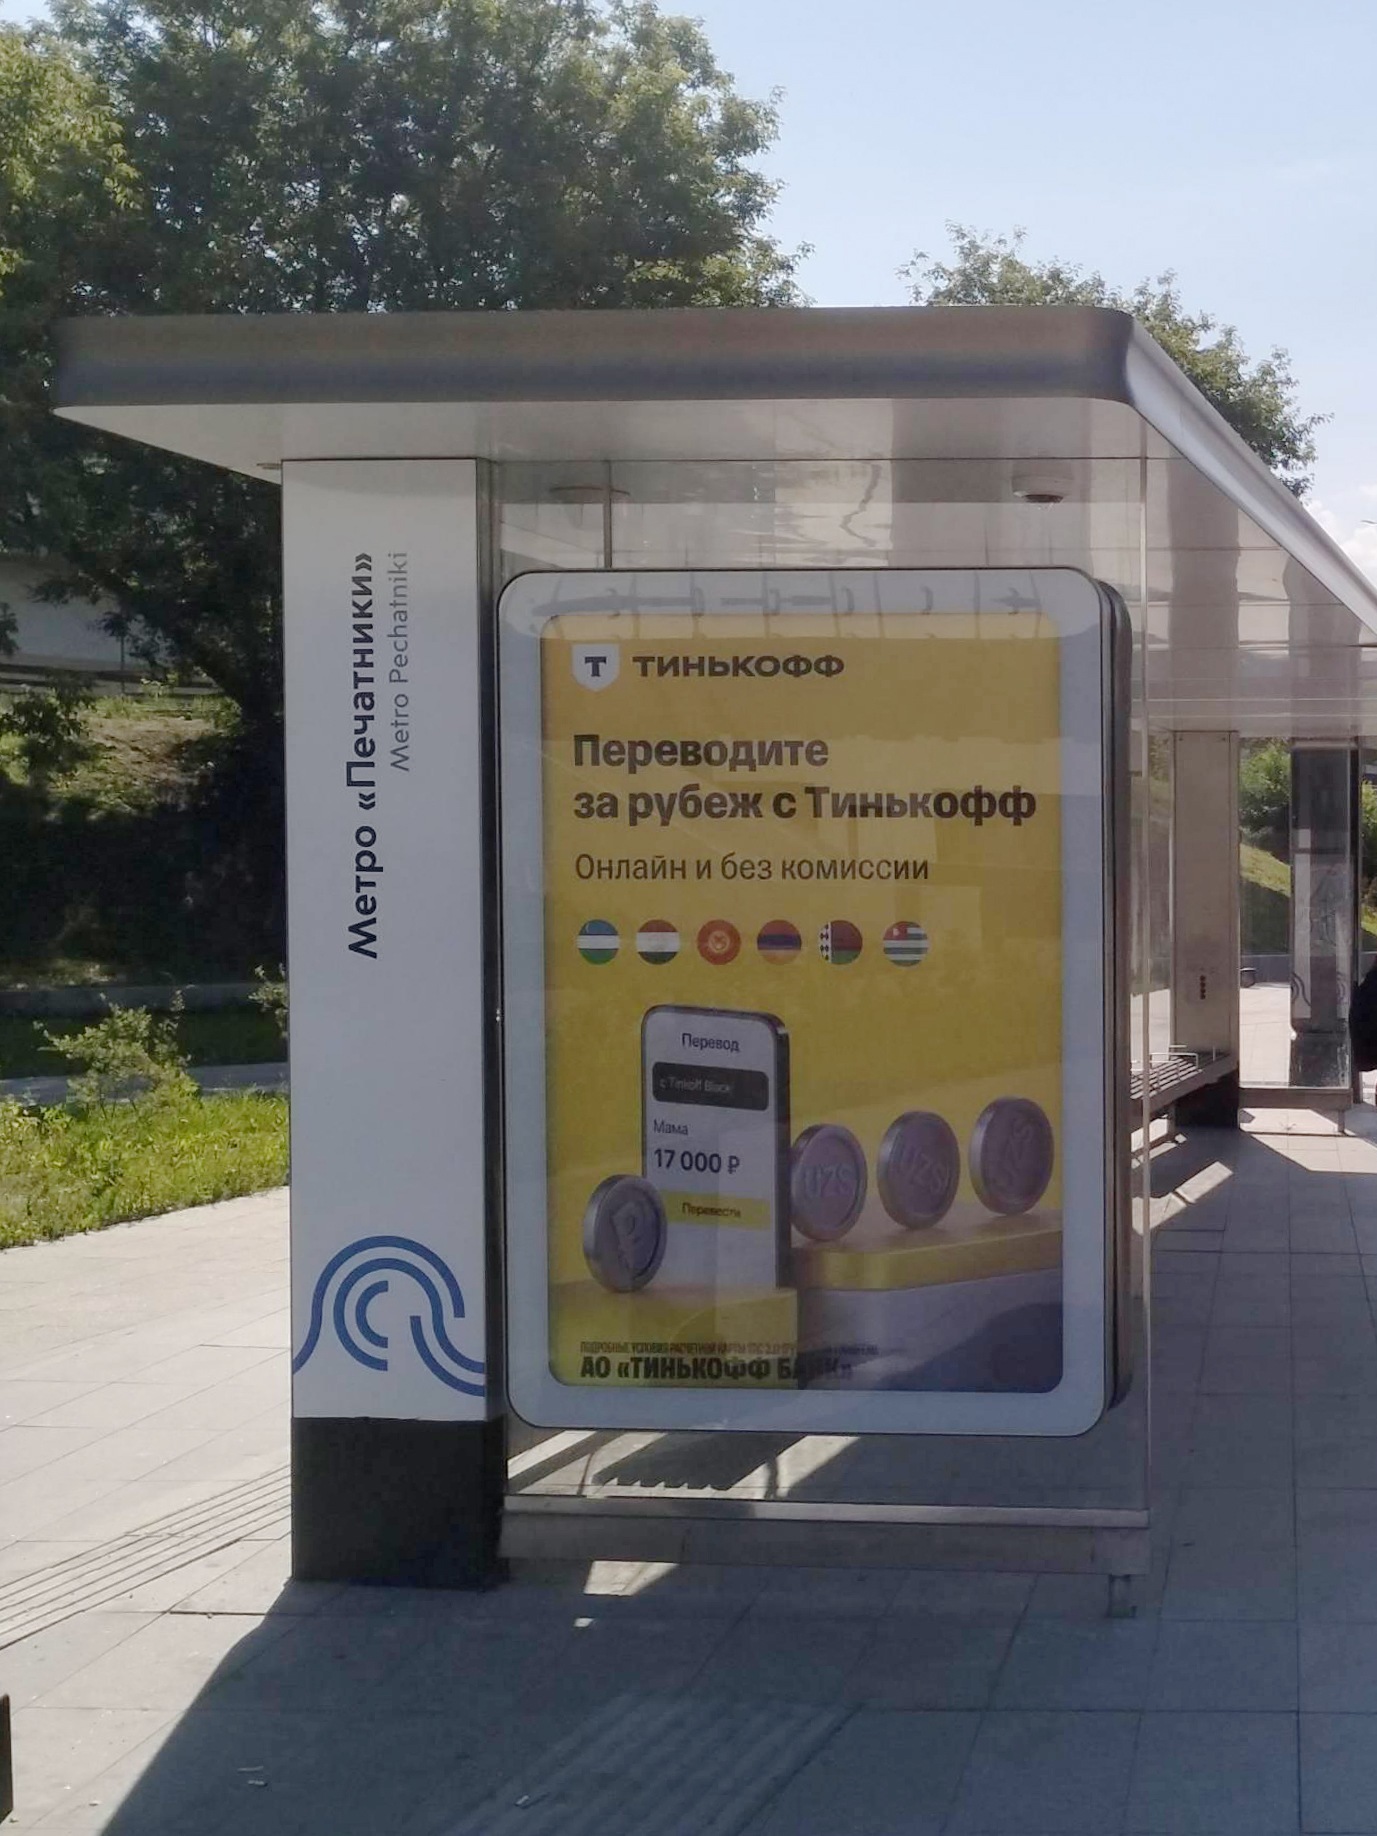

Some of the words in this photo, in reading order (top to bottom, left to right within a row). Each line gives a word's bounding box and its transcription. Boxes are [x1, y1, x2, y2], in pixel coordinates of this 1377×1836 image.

[386, 551, 409, 683] Pechatniki
[346, 552, 377, 811] «Печатники»
[632, 654, 844, 678] ТИНЬКОФФ
[389, 693, 410, 772] Metro
[573, 735, 829, 773] Переводите
[573, 791, 619, 819] за
[628, 784, 763, 826] рубеж
[773, 791, 797, 819] с
[804, 785, 1036, 826] Тинькофф
[575, 853, 687, 881] Онлайн
[696, 858, 711, 880] и
[721, 852, 772, 880] без
[781, 857, 929, 880] комиссии
[347, 824, 384, 959] Метро
[681, 1033, 740, 1053] Перевод
[653, 1119, 689, 1136] Мама
[654, 1149, 675, 1170] 17
[681, 1150, 722, 1173] 000
[804, 1162, 852, 1200] UZS
[681, 1201, 741, 1218] Перевести
[580, 1356, 611, 1378] АО
[617, 1356, 770, 1380] «ТИНЬКОФФ
